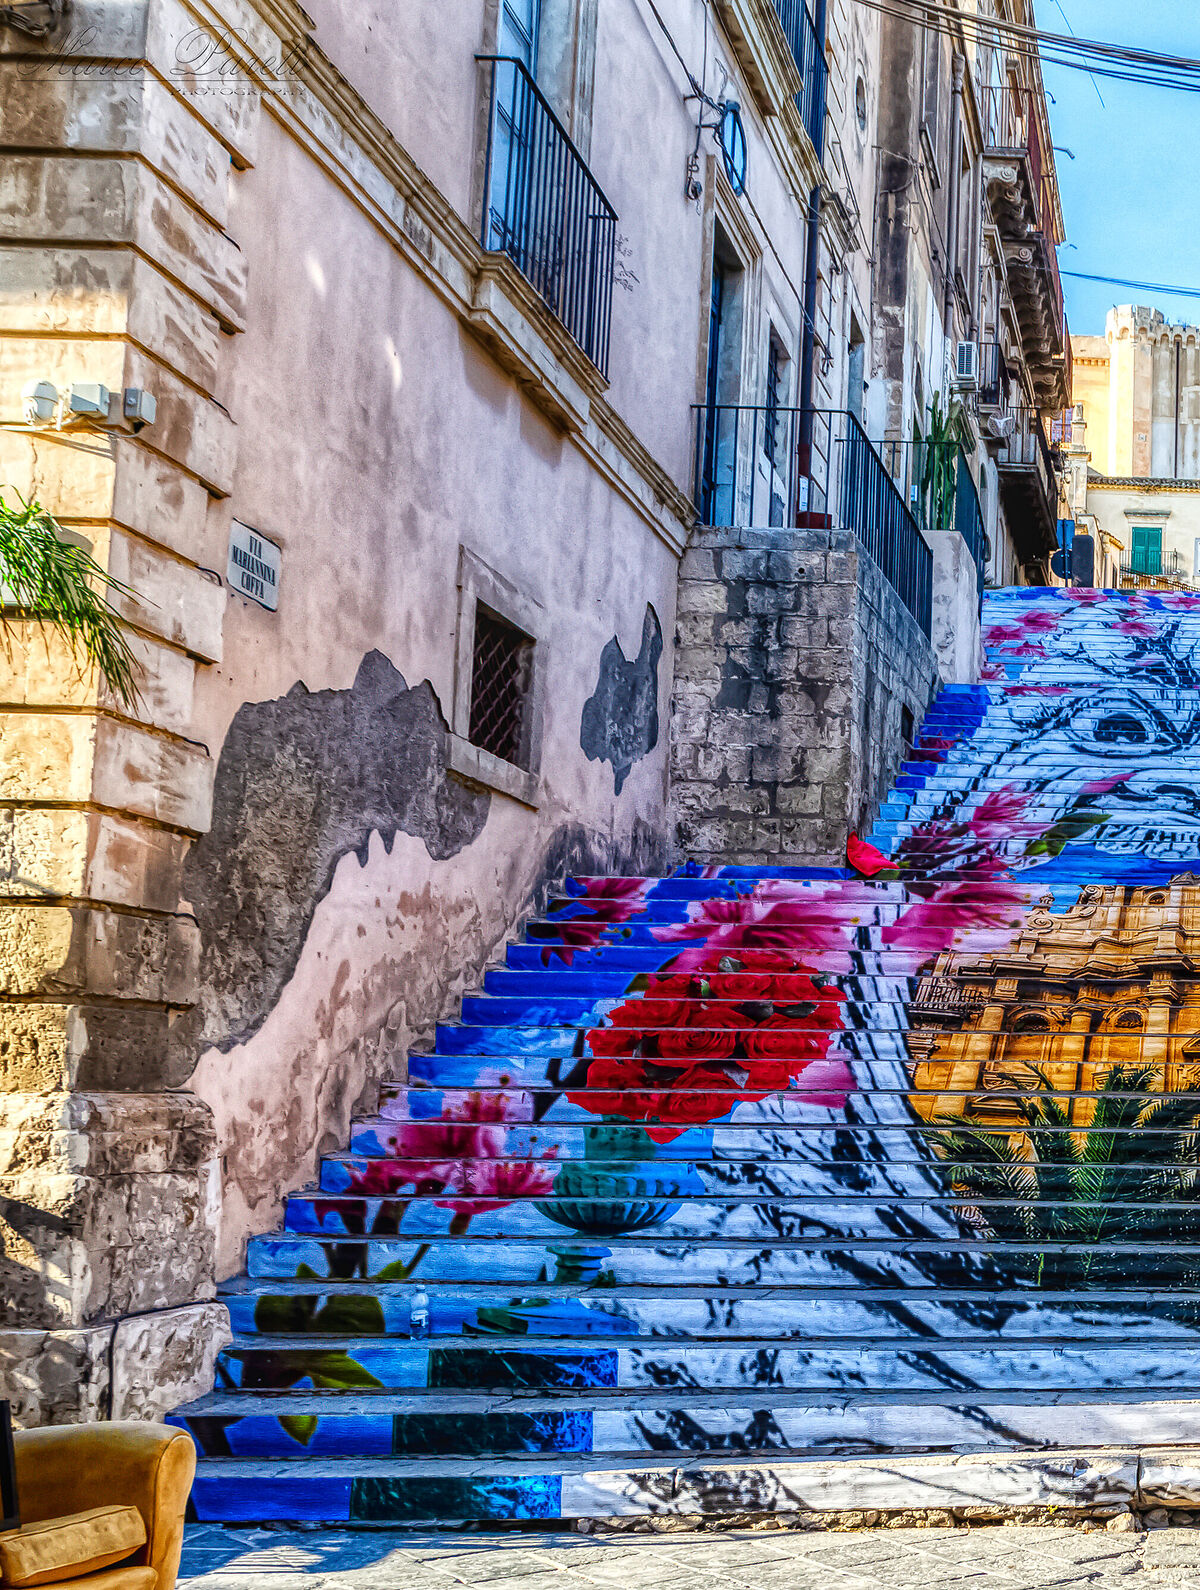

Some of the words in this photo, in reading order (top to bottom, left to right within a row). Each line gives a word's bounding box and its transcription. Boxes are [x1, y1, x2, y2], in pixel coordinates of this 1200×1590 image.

[249, 535, 262, 559] VIA
[232, 544, 276, 587] MARIANNINA
[241, 571, 264, 599] COFFA
